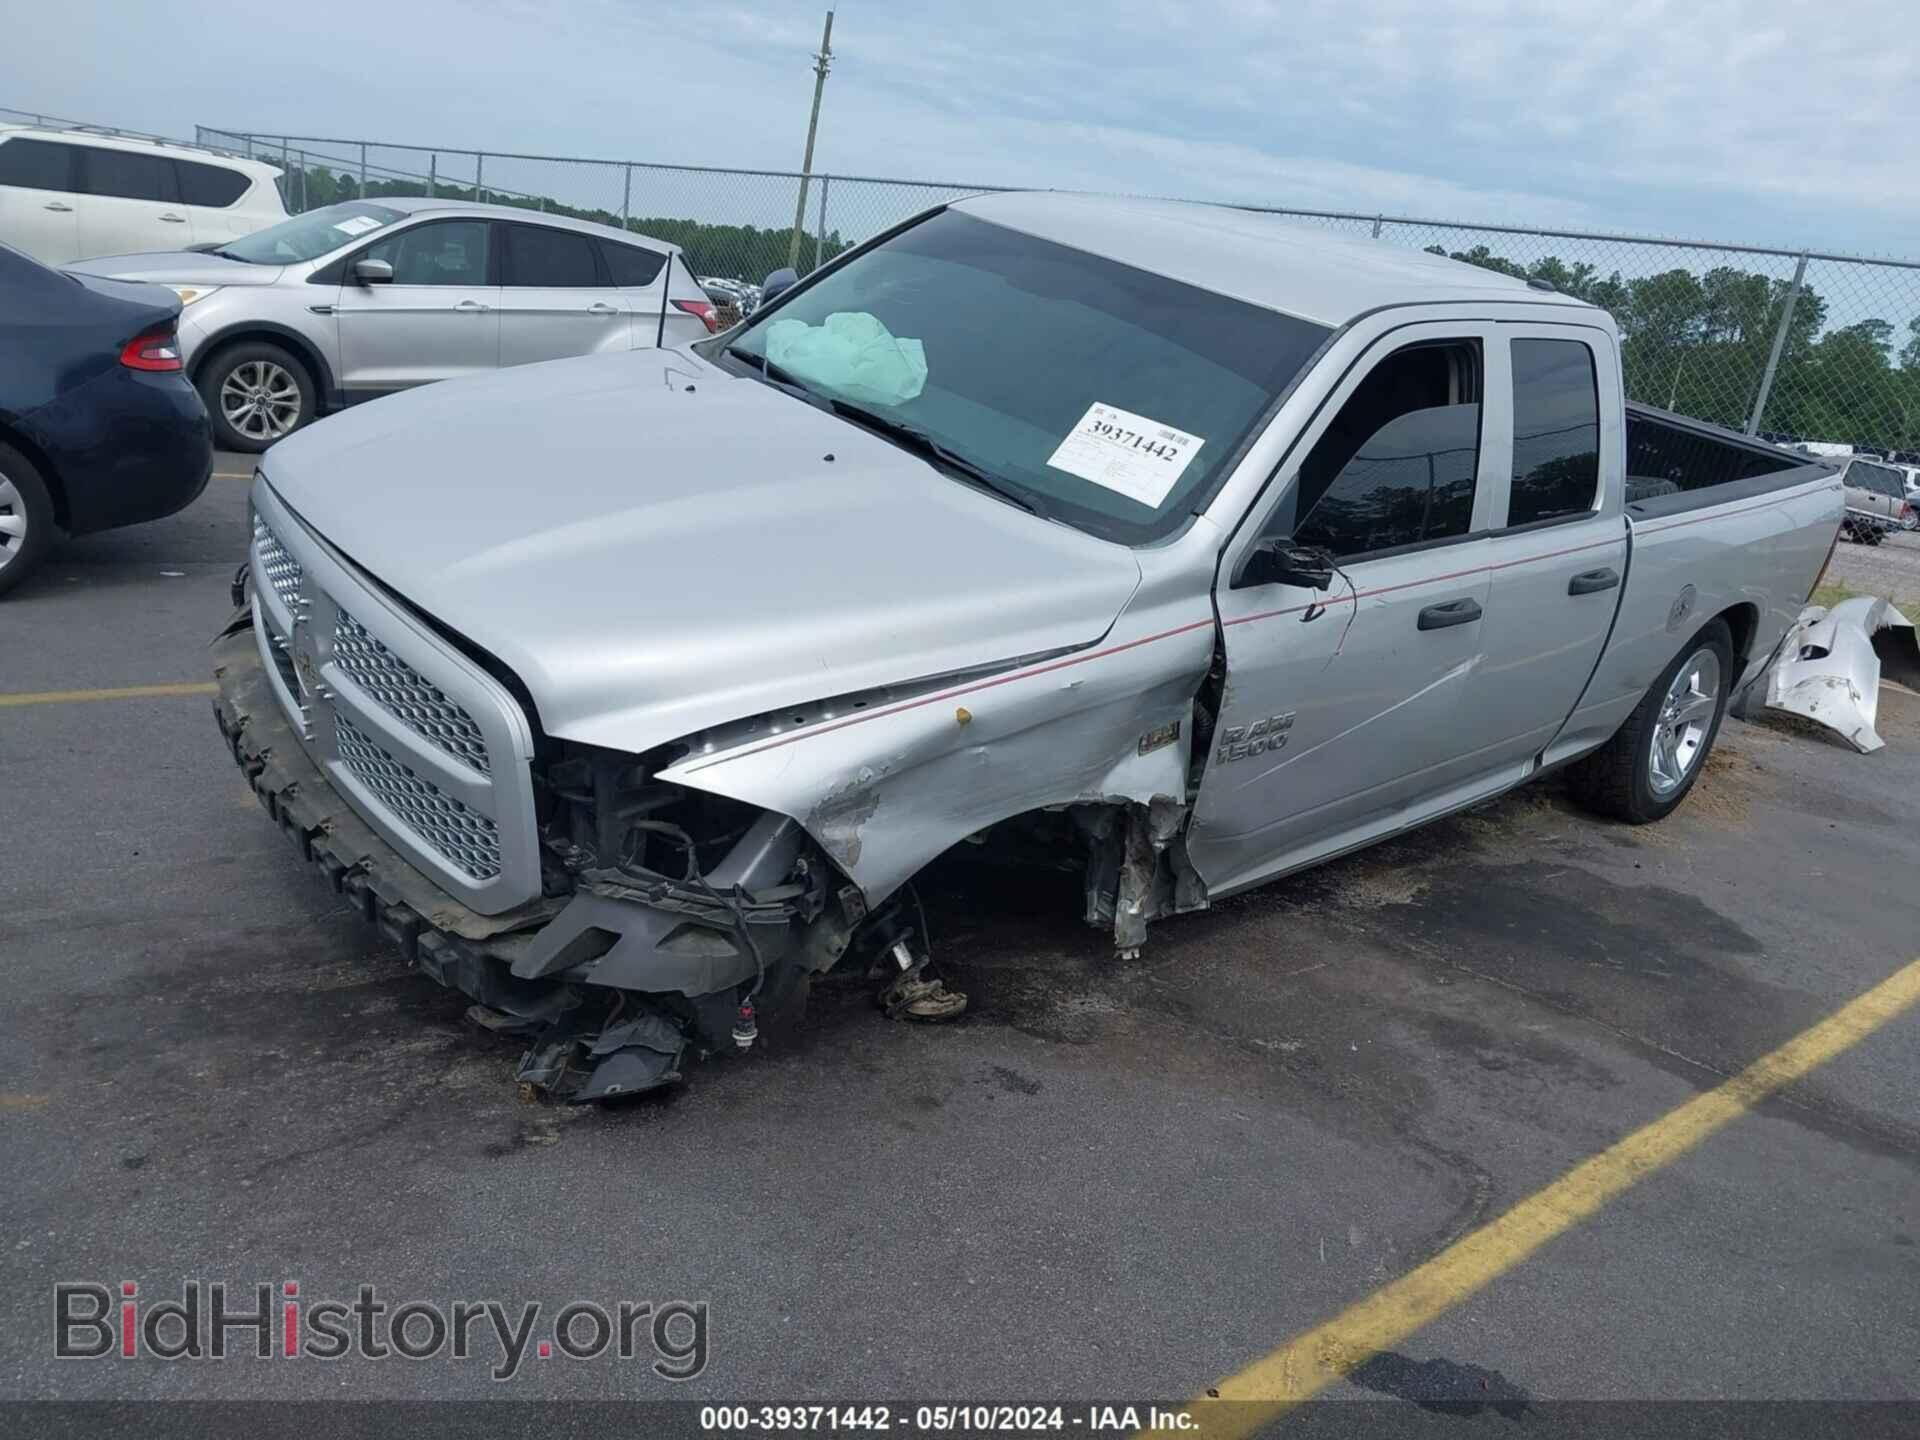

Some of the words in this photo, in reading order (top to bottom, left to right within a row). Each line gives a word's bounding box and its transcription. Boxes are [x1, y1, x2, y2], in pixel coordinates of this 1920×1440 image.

[1088, 420, 1178, 462] 39371442
[1221, 711, 1297, 744] RAM
[1215, 731, 1289, 766] 1500
